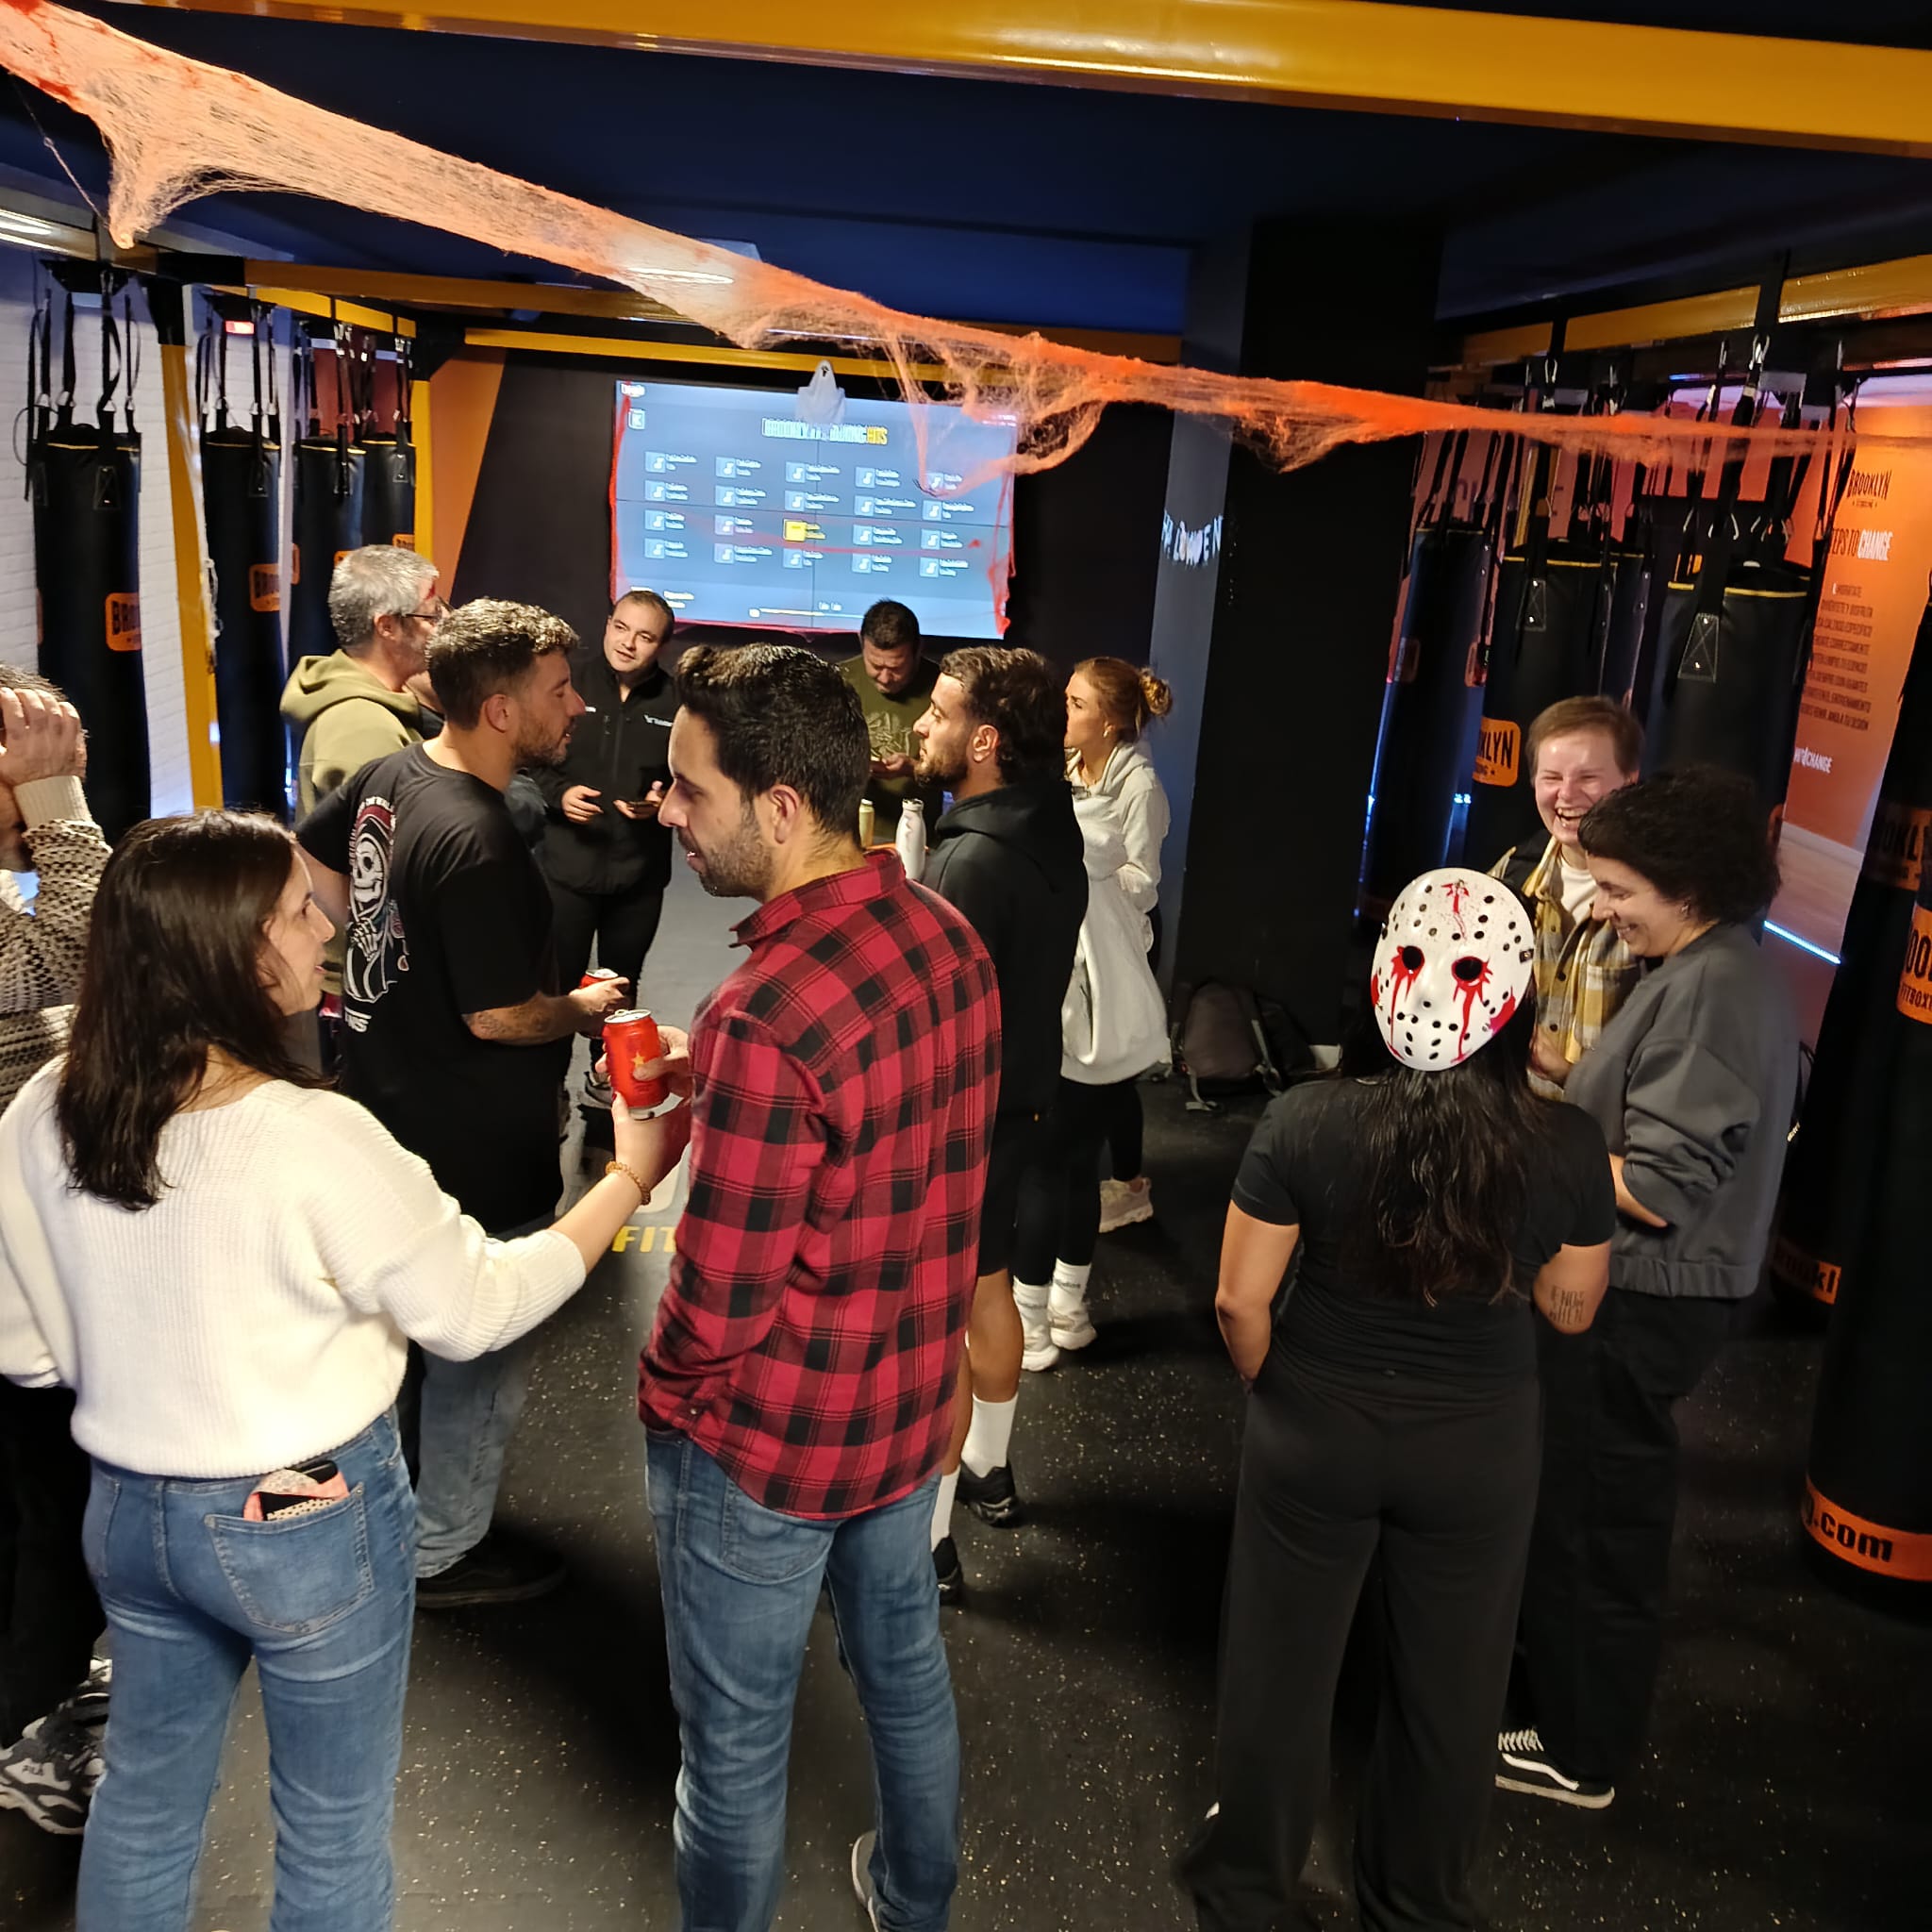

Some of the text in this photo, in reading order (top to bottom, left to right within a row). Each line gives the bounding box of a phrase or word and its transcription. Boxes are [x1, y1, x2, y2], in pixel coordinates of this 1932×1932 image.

[1847, 469, 1891, 500] BROOKLYN
[1857, 528, 1893, 561] CHANGE
[22, 1764, 44, 1776] FILA
